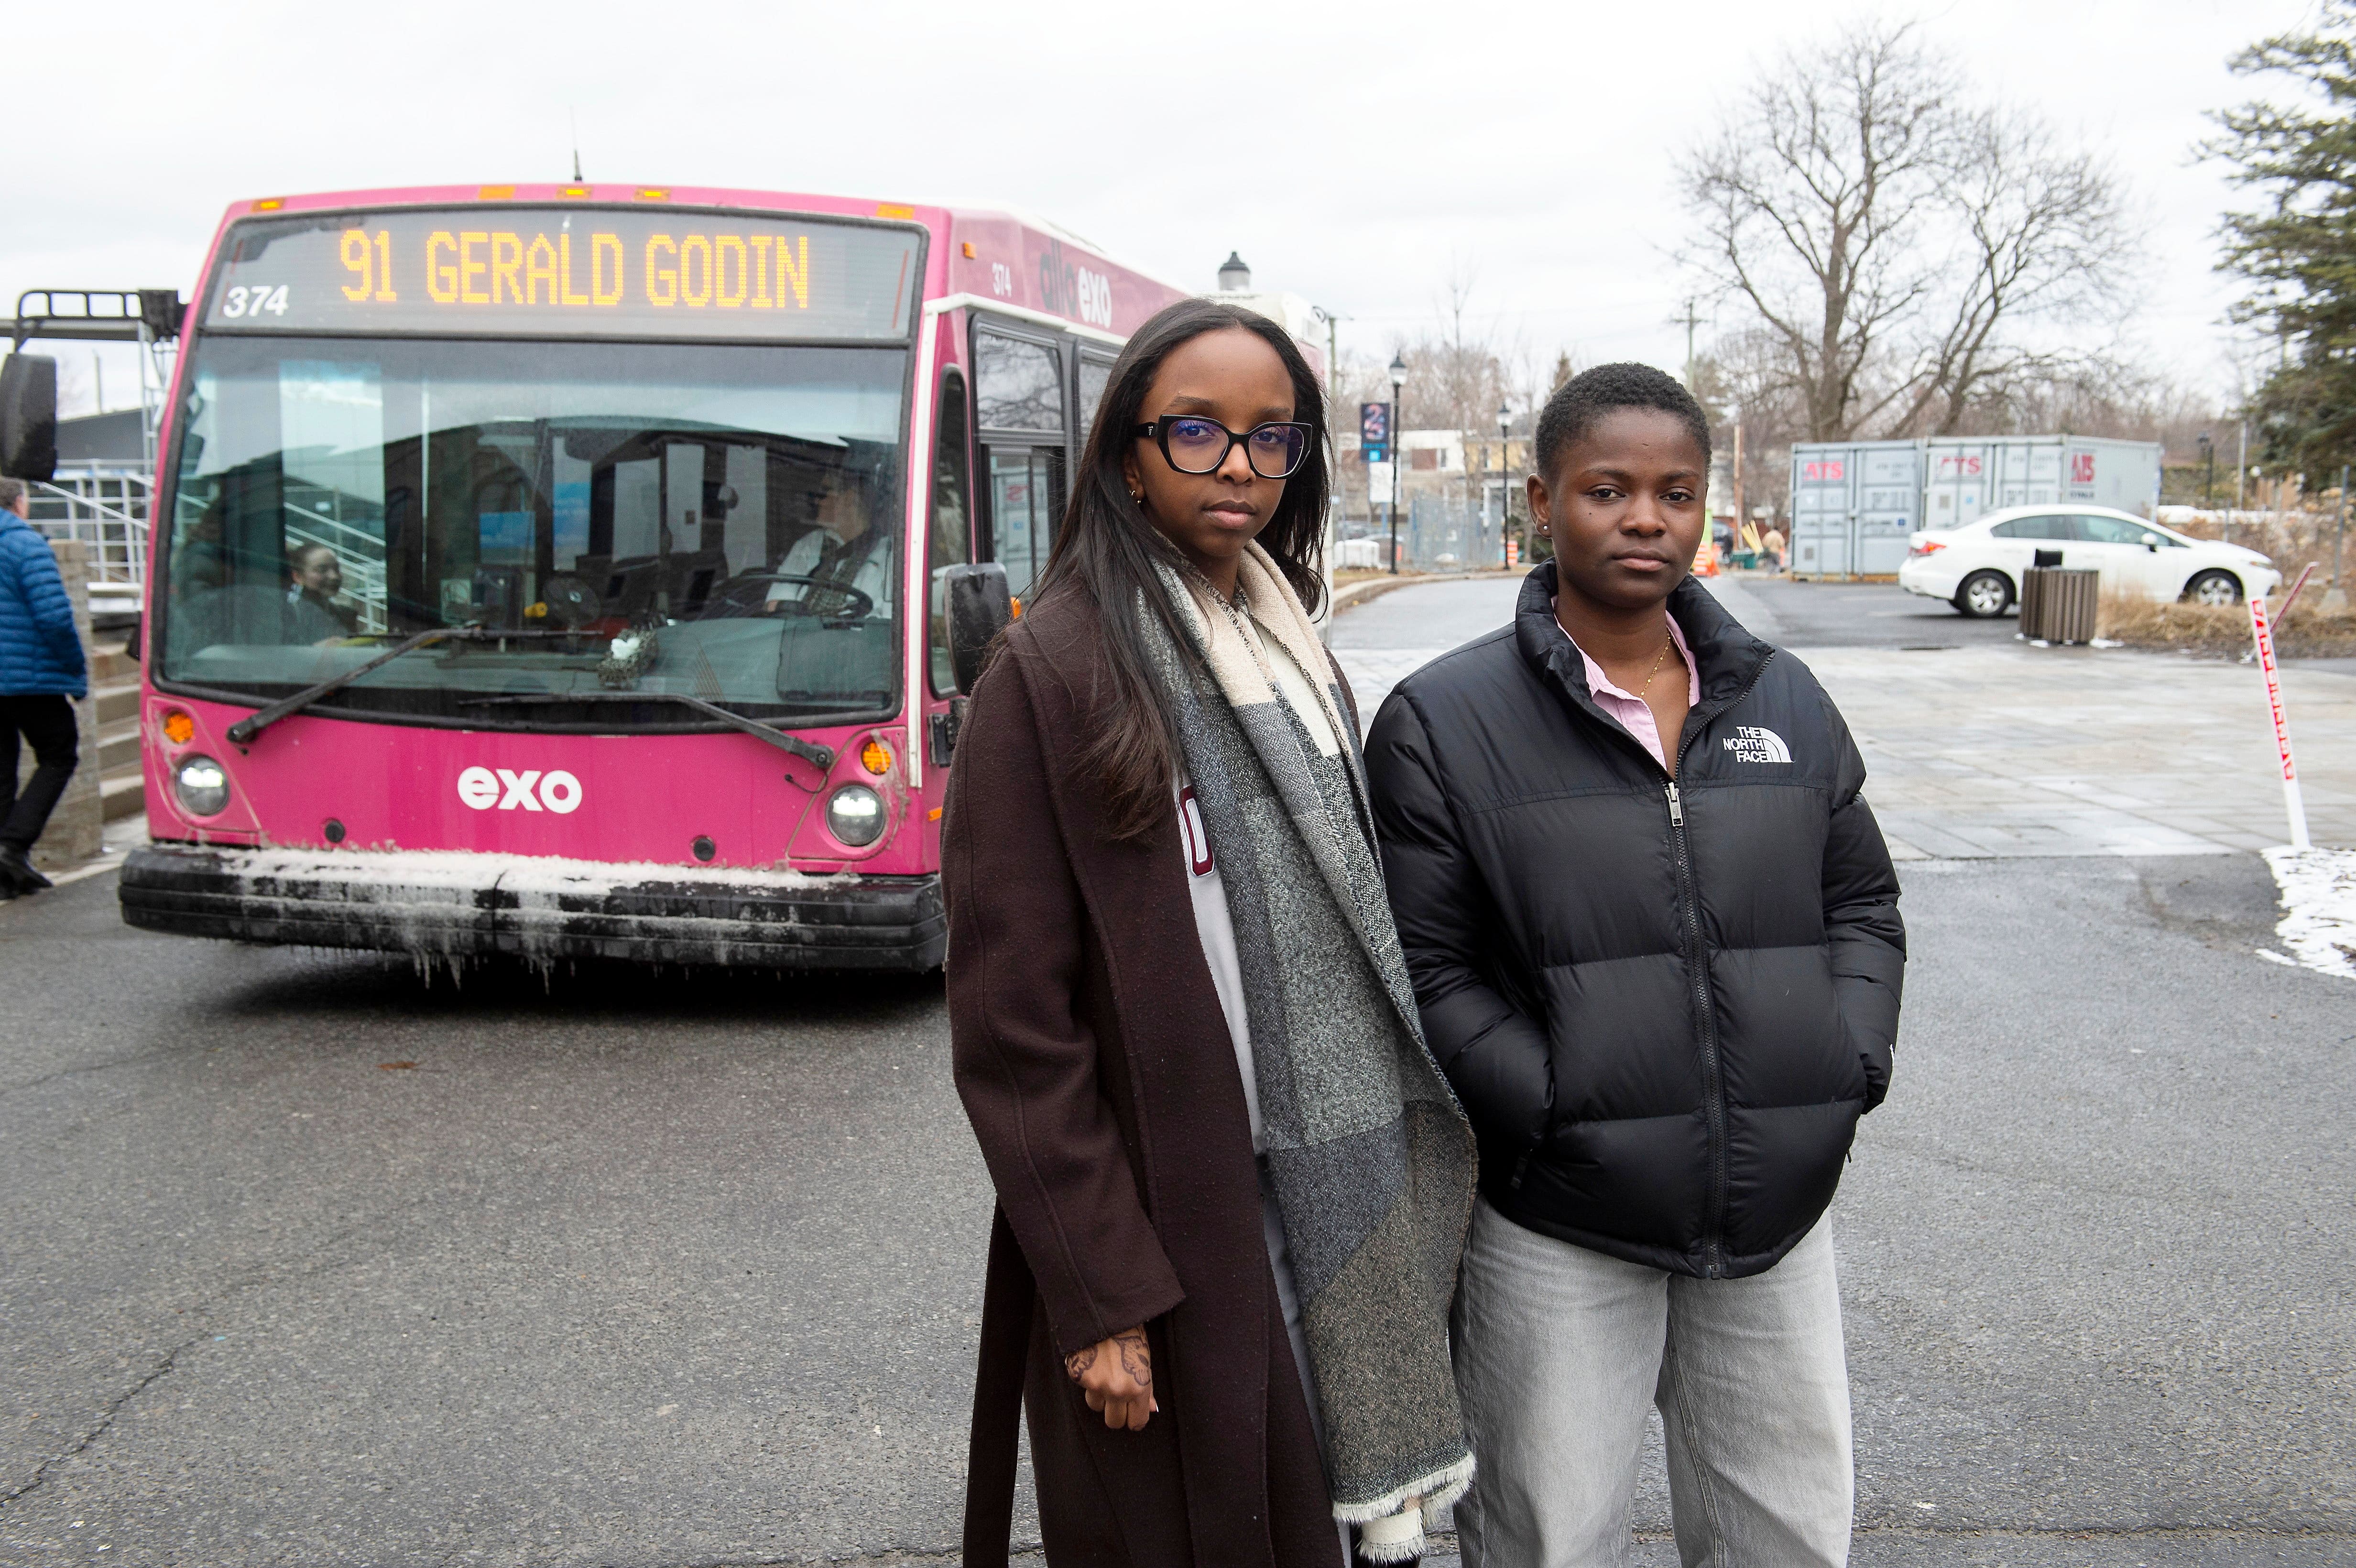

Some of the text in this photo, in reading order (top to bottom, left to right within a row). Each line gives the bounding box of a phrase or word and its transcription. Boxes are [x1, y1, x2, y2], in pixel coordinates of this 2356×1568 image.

[340, 229, 808, 309] 91 GERALD GODIN
[992, 262, 1012, 298] 374
[223, 284, 289, 318] 374
[1803, 461, 1844, 481] ATS
[1723, 738, 1765, 751] NORTH
[1736, 726, 1762, 739] THE
[1735, 750, 1768, 763] FACE
[457, 766, 582, 814] exo
